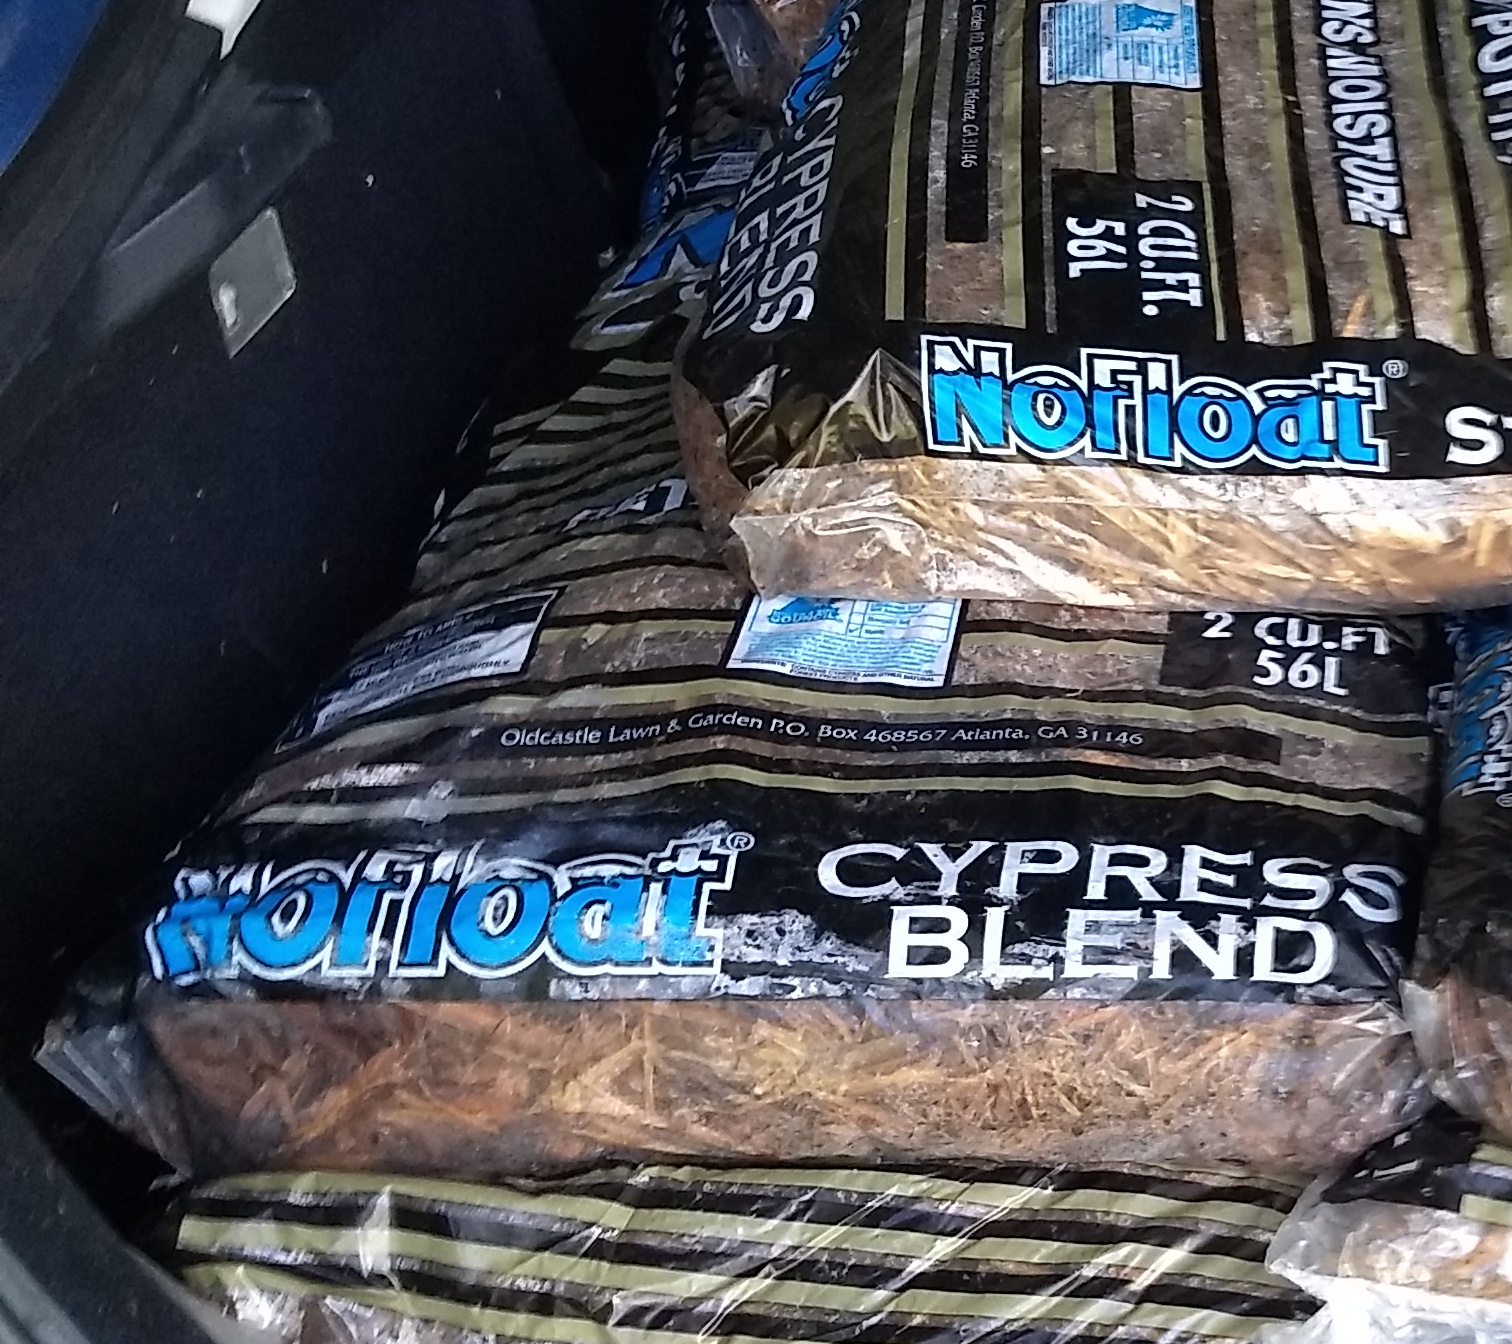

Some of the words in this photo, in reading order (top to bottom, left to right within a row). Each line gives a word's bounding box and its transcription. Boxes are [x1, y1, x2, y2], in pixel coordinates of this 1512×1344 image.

[1323, 45, 1409, 235] MOISTURE
[749, 94, 845, 334] CYPRESS
[1135, 192, 1194, 217] 2
[1065, 216, 1127, 279] 56L
[1201, 611, 1235, 640] 2
[1252, 652, 1350, 698] 56L
[499, 727, 602, 747] Oldcastle
[608, 723, 662, 744] Lawn
[666, 718, 683, 733] &
[688, 710, 764, 730] Garden
[769, 717, 811, 737] P.O.
[818, 723, 859, 742] Box
[862, 727, 950, 744] 468567
[950, 726, 1031, 743] Atlanta,
[1037, 726, 1069, 740] GA
[1074, 726, 1145, 746] 31146
[816, 840, 1408, 923] CYPRESS
[886, 903, 1340, 987] BLEND
